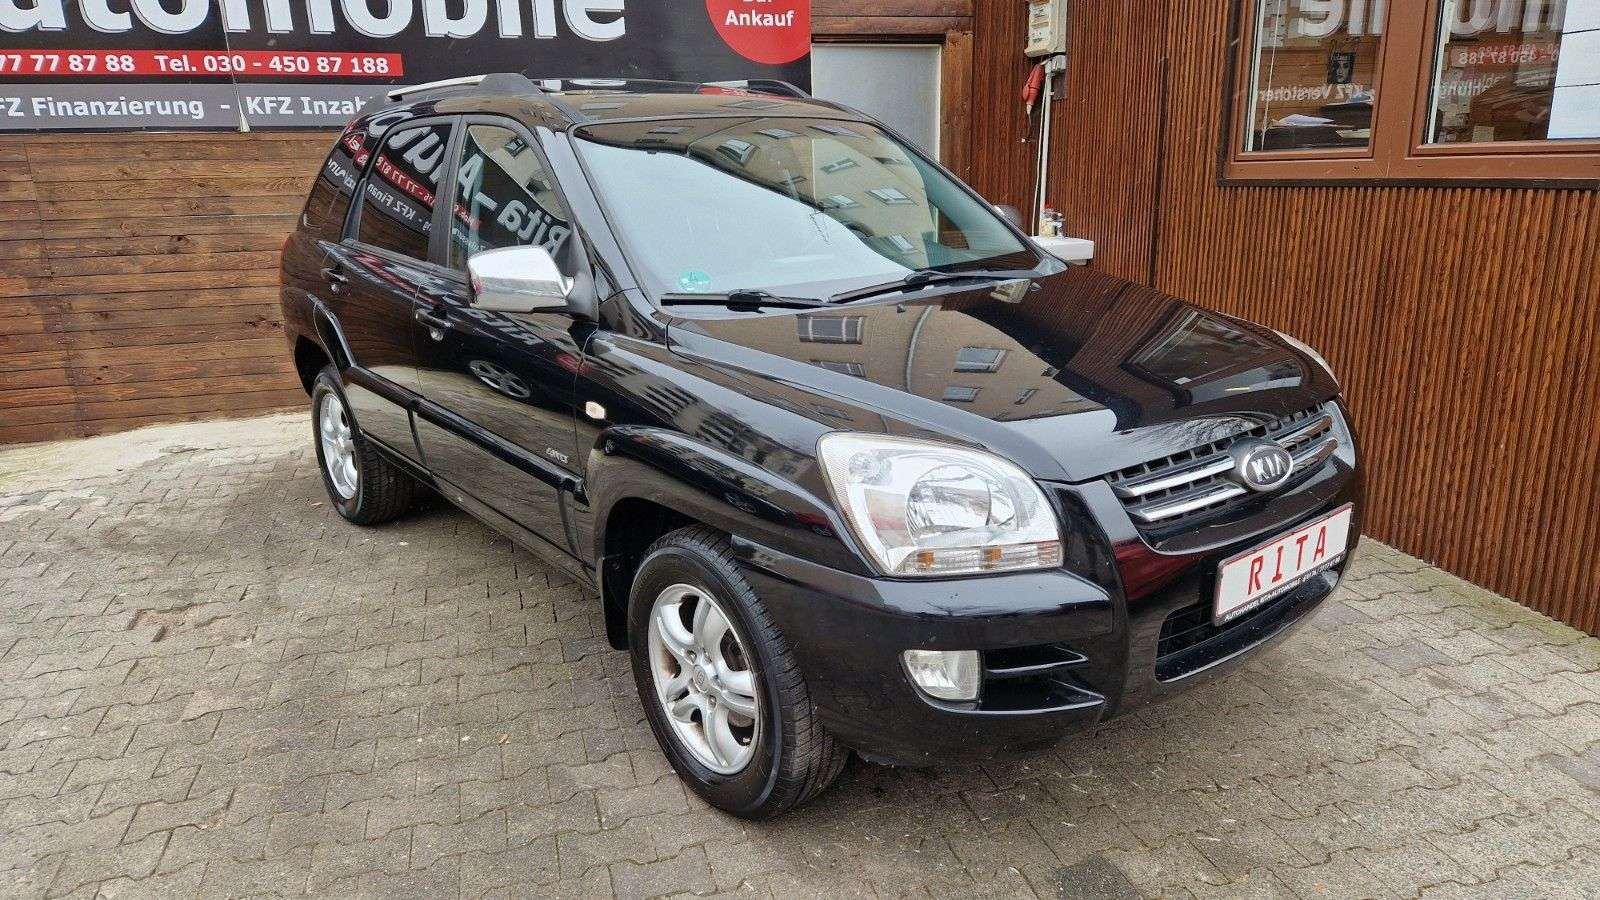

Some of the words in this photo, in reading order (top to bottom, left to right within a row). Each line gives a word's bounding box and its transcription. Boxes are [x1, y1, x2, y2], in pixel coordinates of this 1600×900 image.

[725, 9, 794, 27] Ankauf
[30, 55, 60, 71] 77
[68, 55, 96, 72] 87
[104, 55, 136, 72] 88
[153, 55, 197, 72] Tel.
[203, 55, 246, 72] 030
[269, 56, 310, 73] 450
[316, 57, 342, 73] 87
[351, 57, 389, 74] 188
[31, 96, 205, 120] Finanzierung
[246, 96, 295, 115] KFZ
[1251, 453, 1289, 483] KIA
